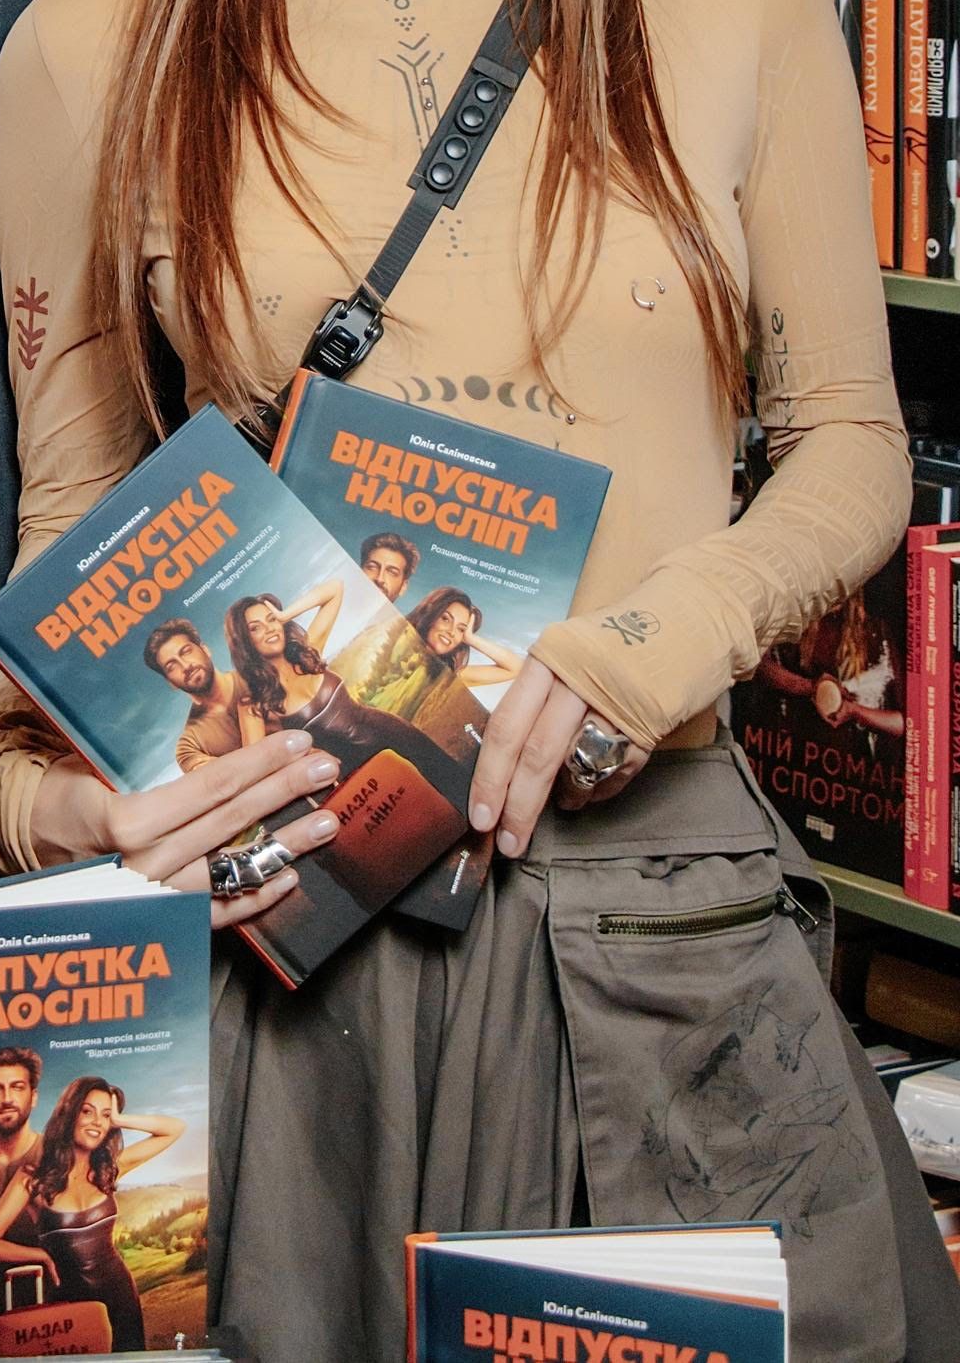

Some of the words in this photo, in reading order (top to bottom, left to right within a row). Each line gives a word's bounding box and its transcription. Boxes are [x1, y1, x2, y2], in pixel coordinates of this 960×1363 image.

[927, 58, 944, 117] ЯРЛИКІВ
[409, 434, 436, 451] Юлія
[436, 442, 497, 470] Салімовська
[329, 429, 558, 530] ВІДПУСТКА
[77, 549, 102, 572] Юлія
[98, 504, 151, 552] Салімовська
[344, 472, 530, 556] НАОСЛІП
[35, 470, 235, 651] ВІДПУСТКА
[79, 508, 239, 658] НАОСЛІП
[183, 569, 224, 607] Розширена
[221, 549, 248, 577] версія
[244, 524, 274, 555] кінохіта
[431, 543, 478, 565] Розширена
[479, 559, 506, 575] версія
[507, 566, 540, 585] кінохіта
[928, 567, 936, 593] ОЛЕГ
[928, 594, 936, 642] ЛУЖНИЙ
[927, 686, 935, 706] БЕЗ
[744, 723, 792, 762] МІЙ
[804, 741, 904, 791] РОМАН
[339, 778, 379, 827] НАЗАР
[772, 766, 904, 828] СПОРТОМ
[23, 932, 90, 947] Салімовська
[49, 1037, 101, 1050] Розширена
[103, 1033, 133, 1046] версія
[135, 1030, 171, 1043] кінохіта
[15, 1319, 74, 1345] НАЗАР
[464, 1308, 731, 1363] ВІДПУСТК
[543, 1300, 573, 1315] Юлія
[575, 1306, 648, 1329] Салімовська
